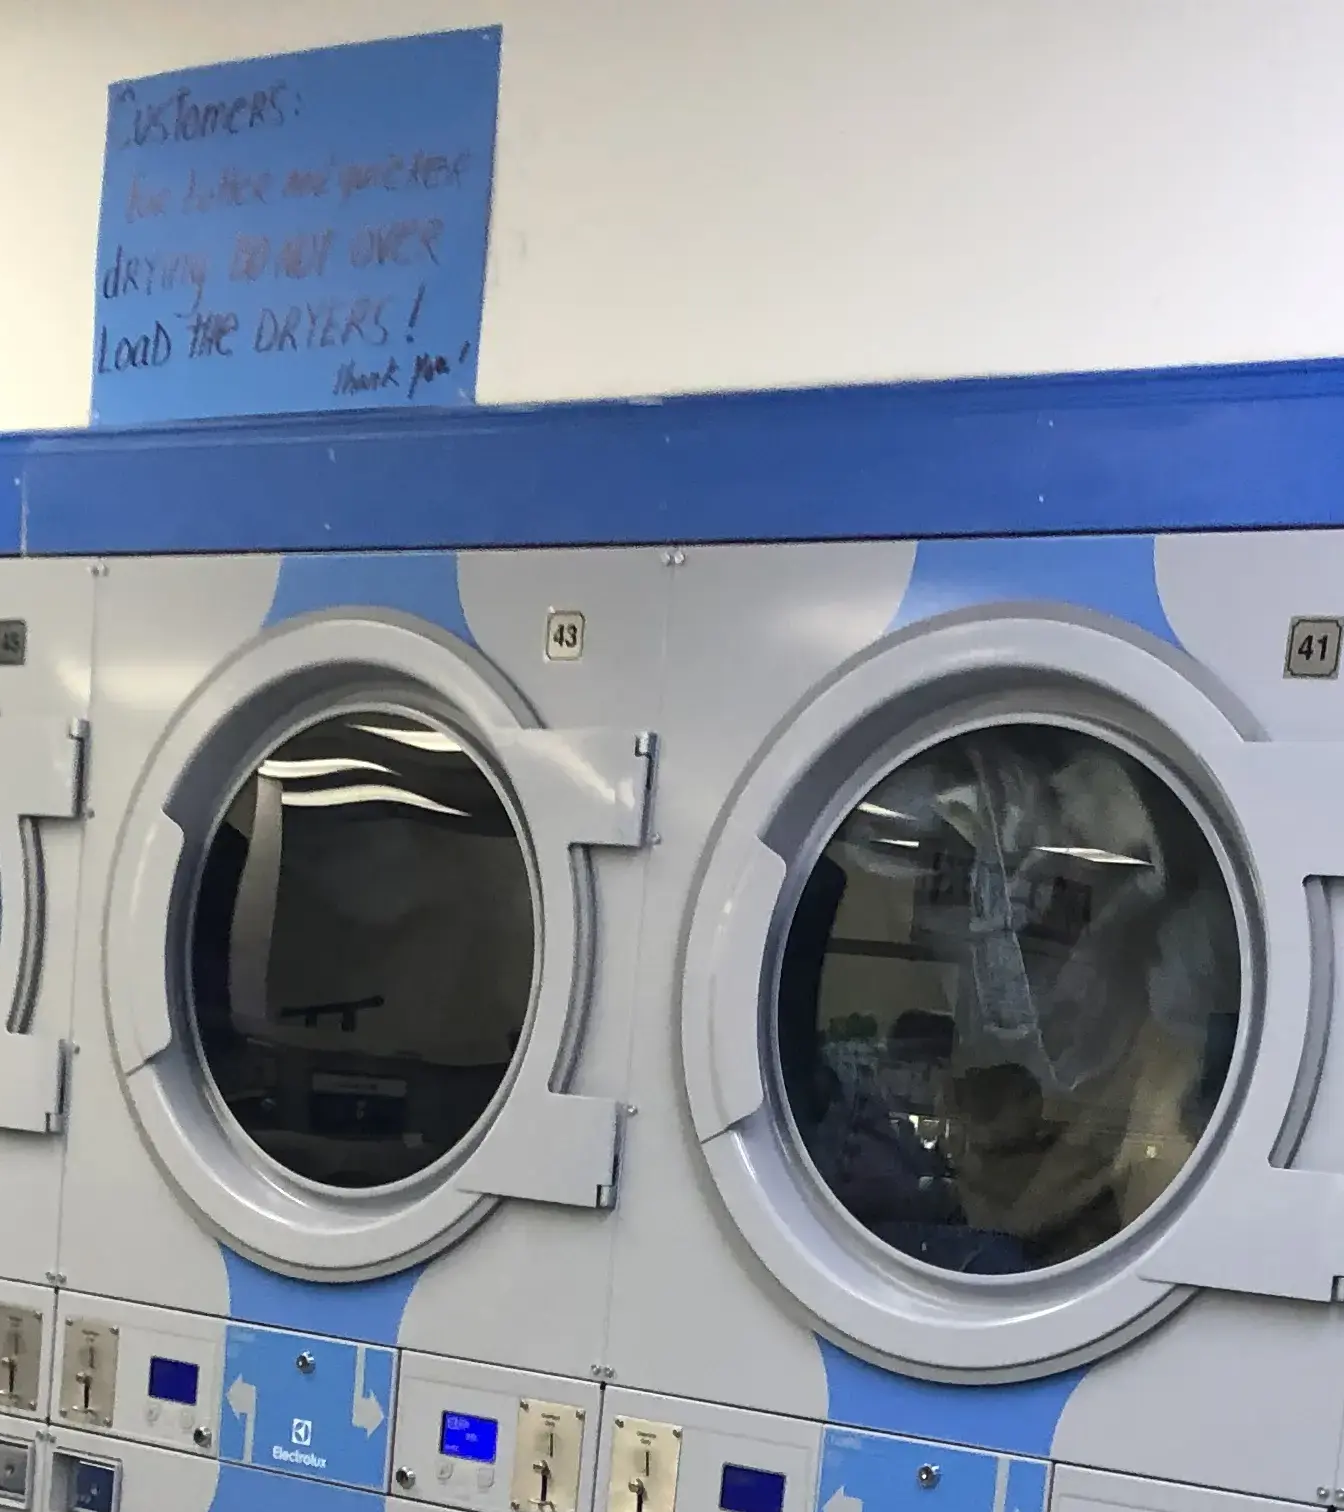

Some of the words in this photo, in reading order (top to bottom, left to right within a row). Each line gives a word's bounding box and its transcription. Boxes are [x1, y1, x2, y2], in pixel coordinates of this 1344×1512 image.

[553, 624, 577, 648] 43
[1298, 634, 1328, 661] 41
[272, 1445, 327, 1469] Electrolux
